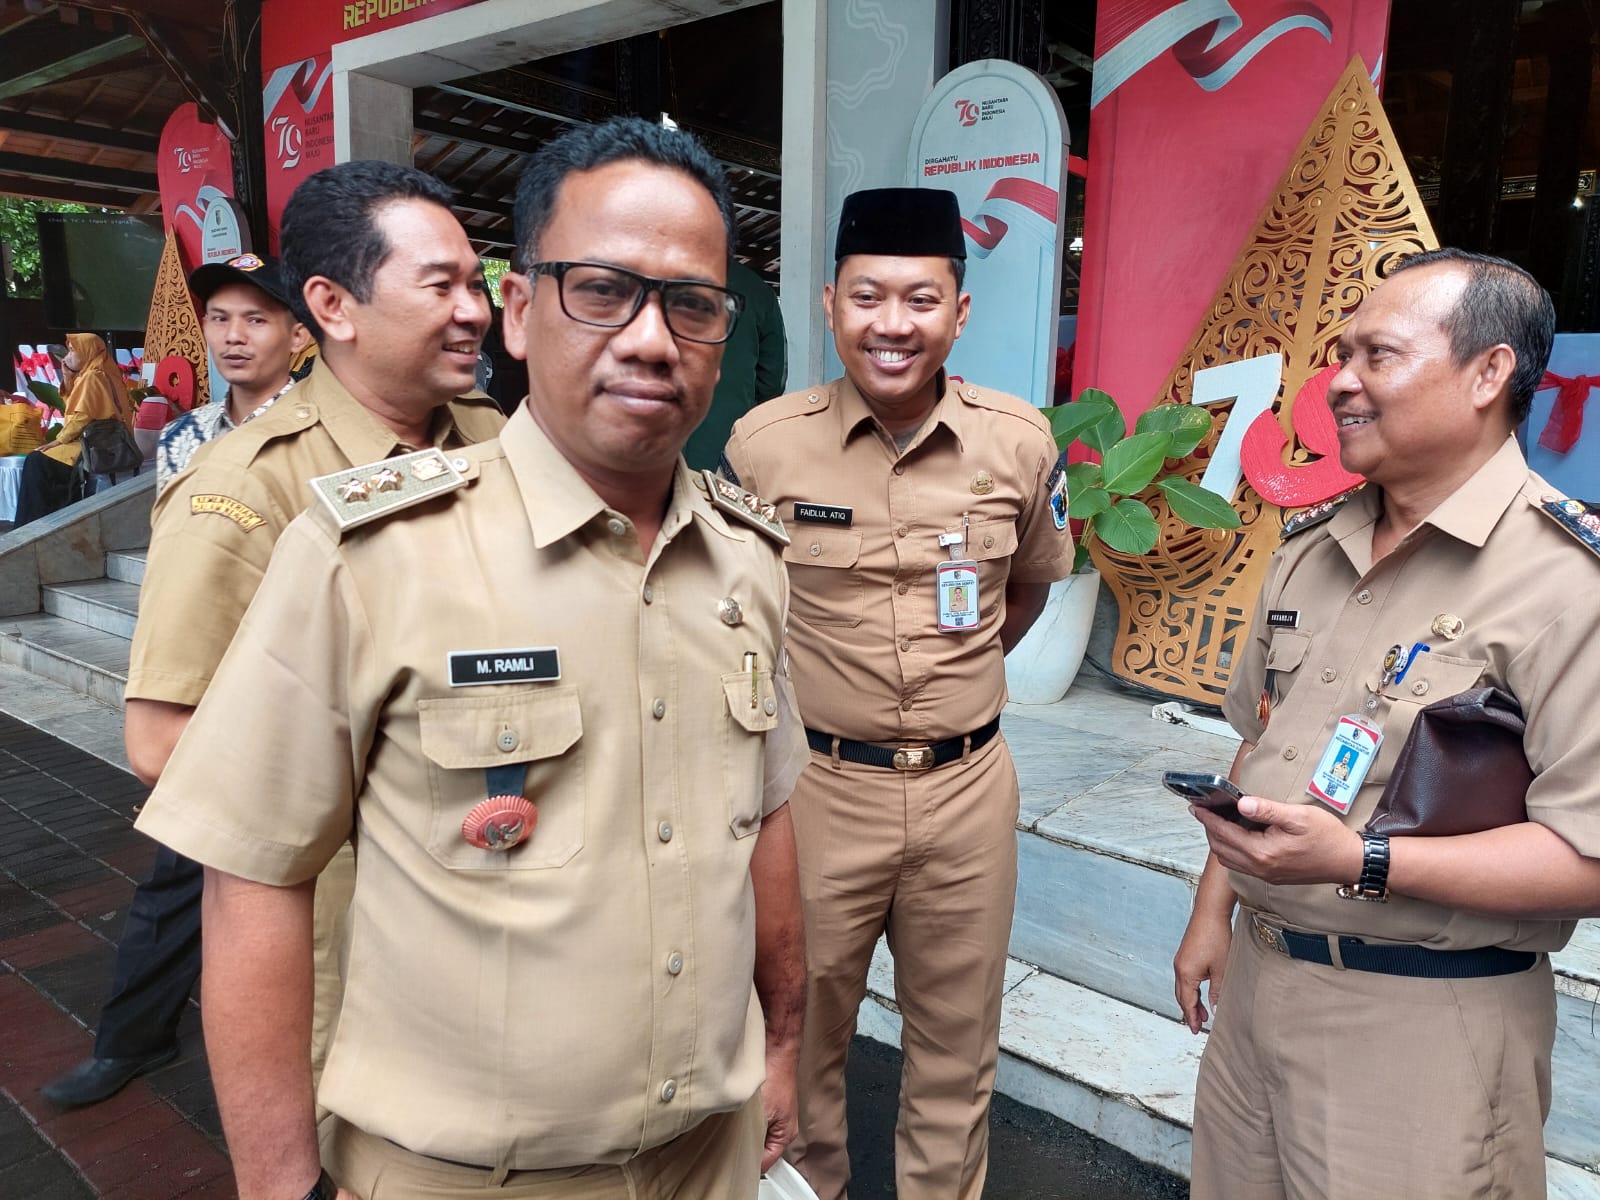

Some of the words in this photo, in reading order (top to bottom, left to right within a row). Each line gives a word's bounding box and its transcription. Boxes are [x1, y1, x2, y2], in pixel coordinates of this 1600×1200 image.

[343, 0, 437, 30] REPUB
[955, 99, 980, 127] 79
[271, 115, 302, 169] 79
[924, 155, 959, 165] DIRGAHAYU
[924, 160, 977, 177] REPUBLIK
[979, 152, 1040, 170] INDONESIA
[800, 508, 828, 518] FAIDLUL
[830, 511, 846, 520] ATIQ
[476, 659, 492, 674] M.
[494, 657, 534, 674] RAMLI
